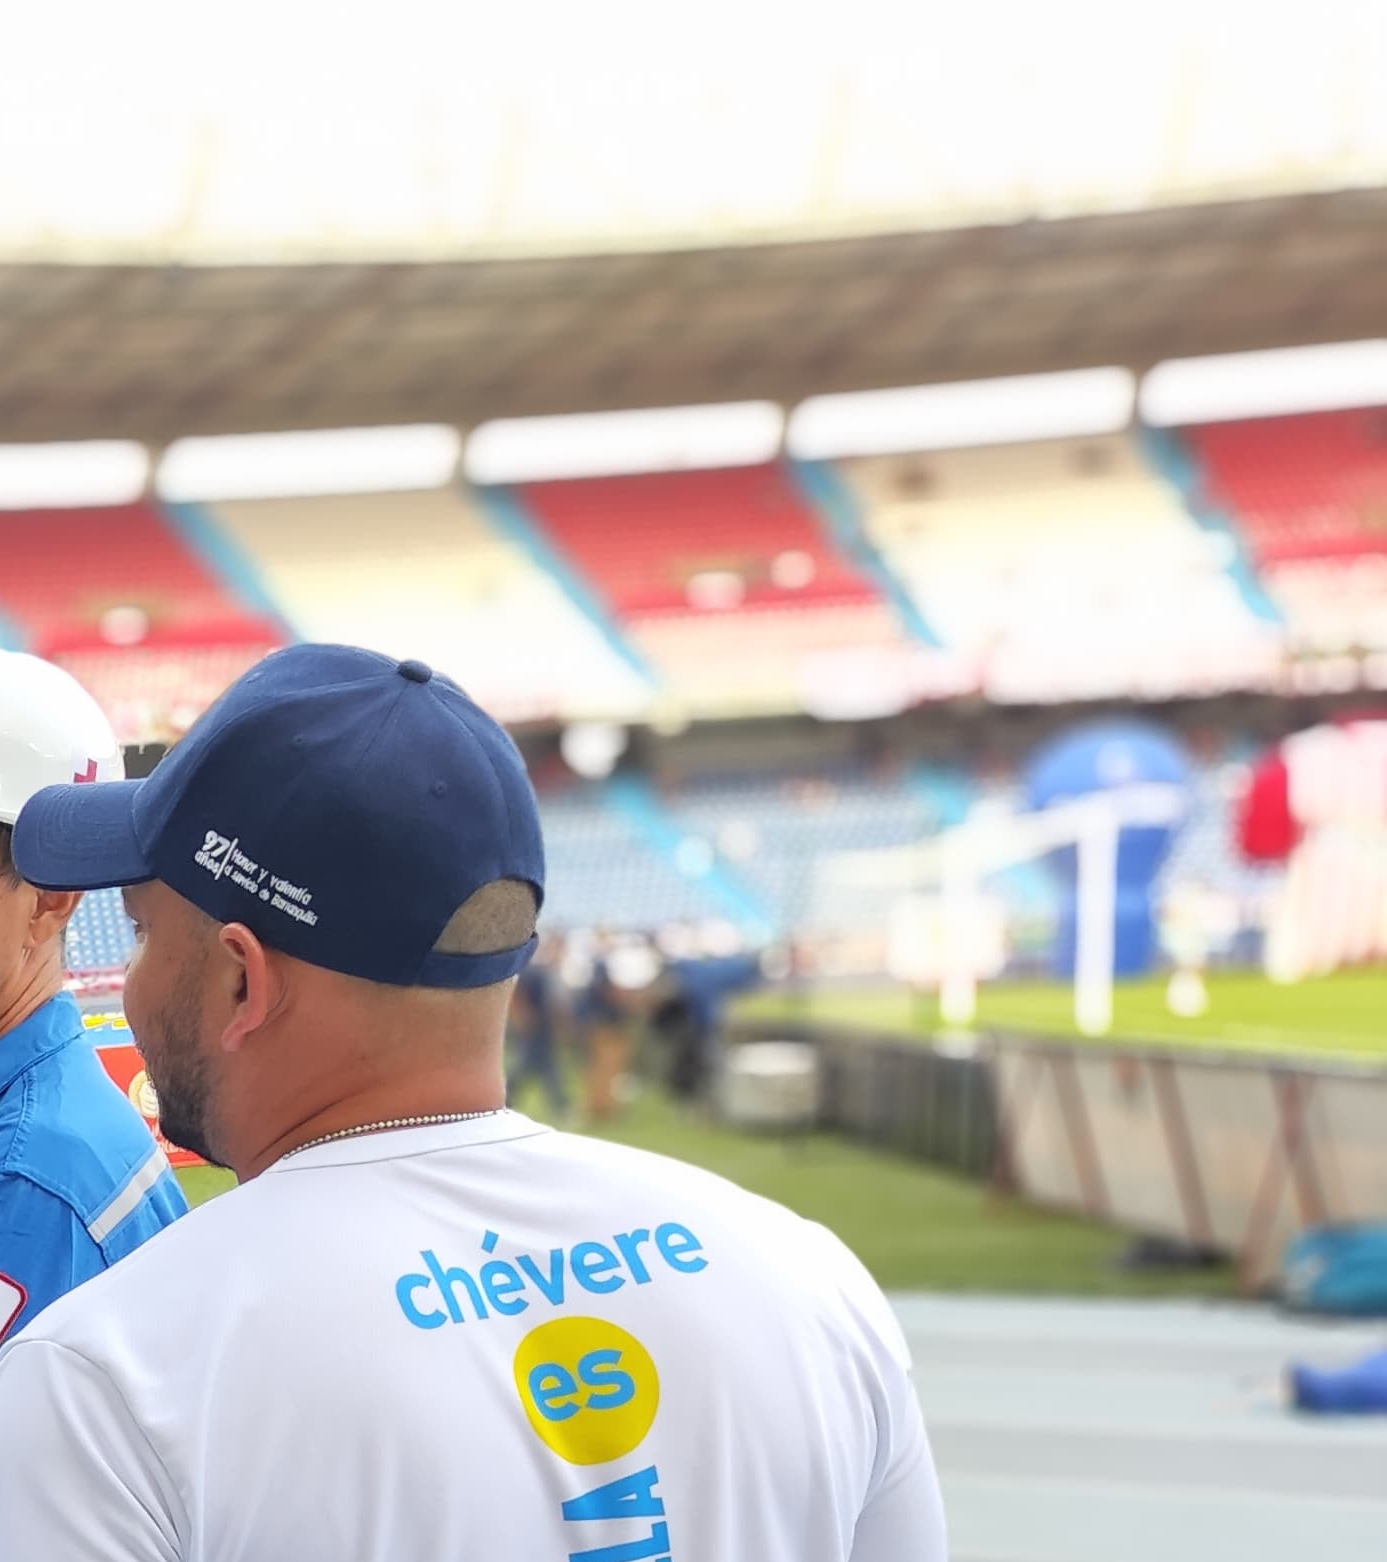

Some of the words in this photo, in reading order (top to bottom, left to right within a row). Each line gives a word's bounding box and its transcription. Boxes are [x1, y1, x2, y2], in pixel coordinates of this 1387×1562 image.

[202, 830, 231, 857] 97
[394, 1220, 710, 1330] chévere
[528, 1348, 636, 1422] es
